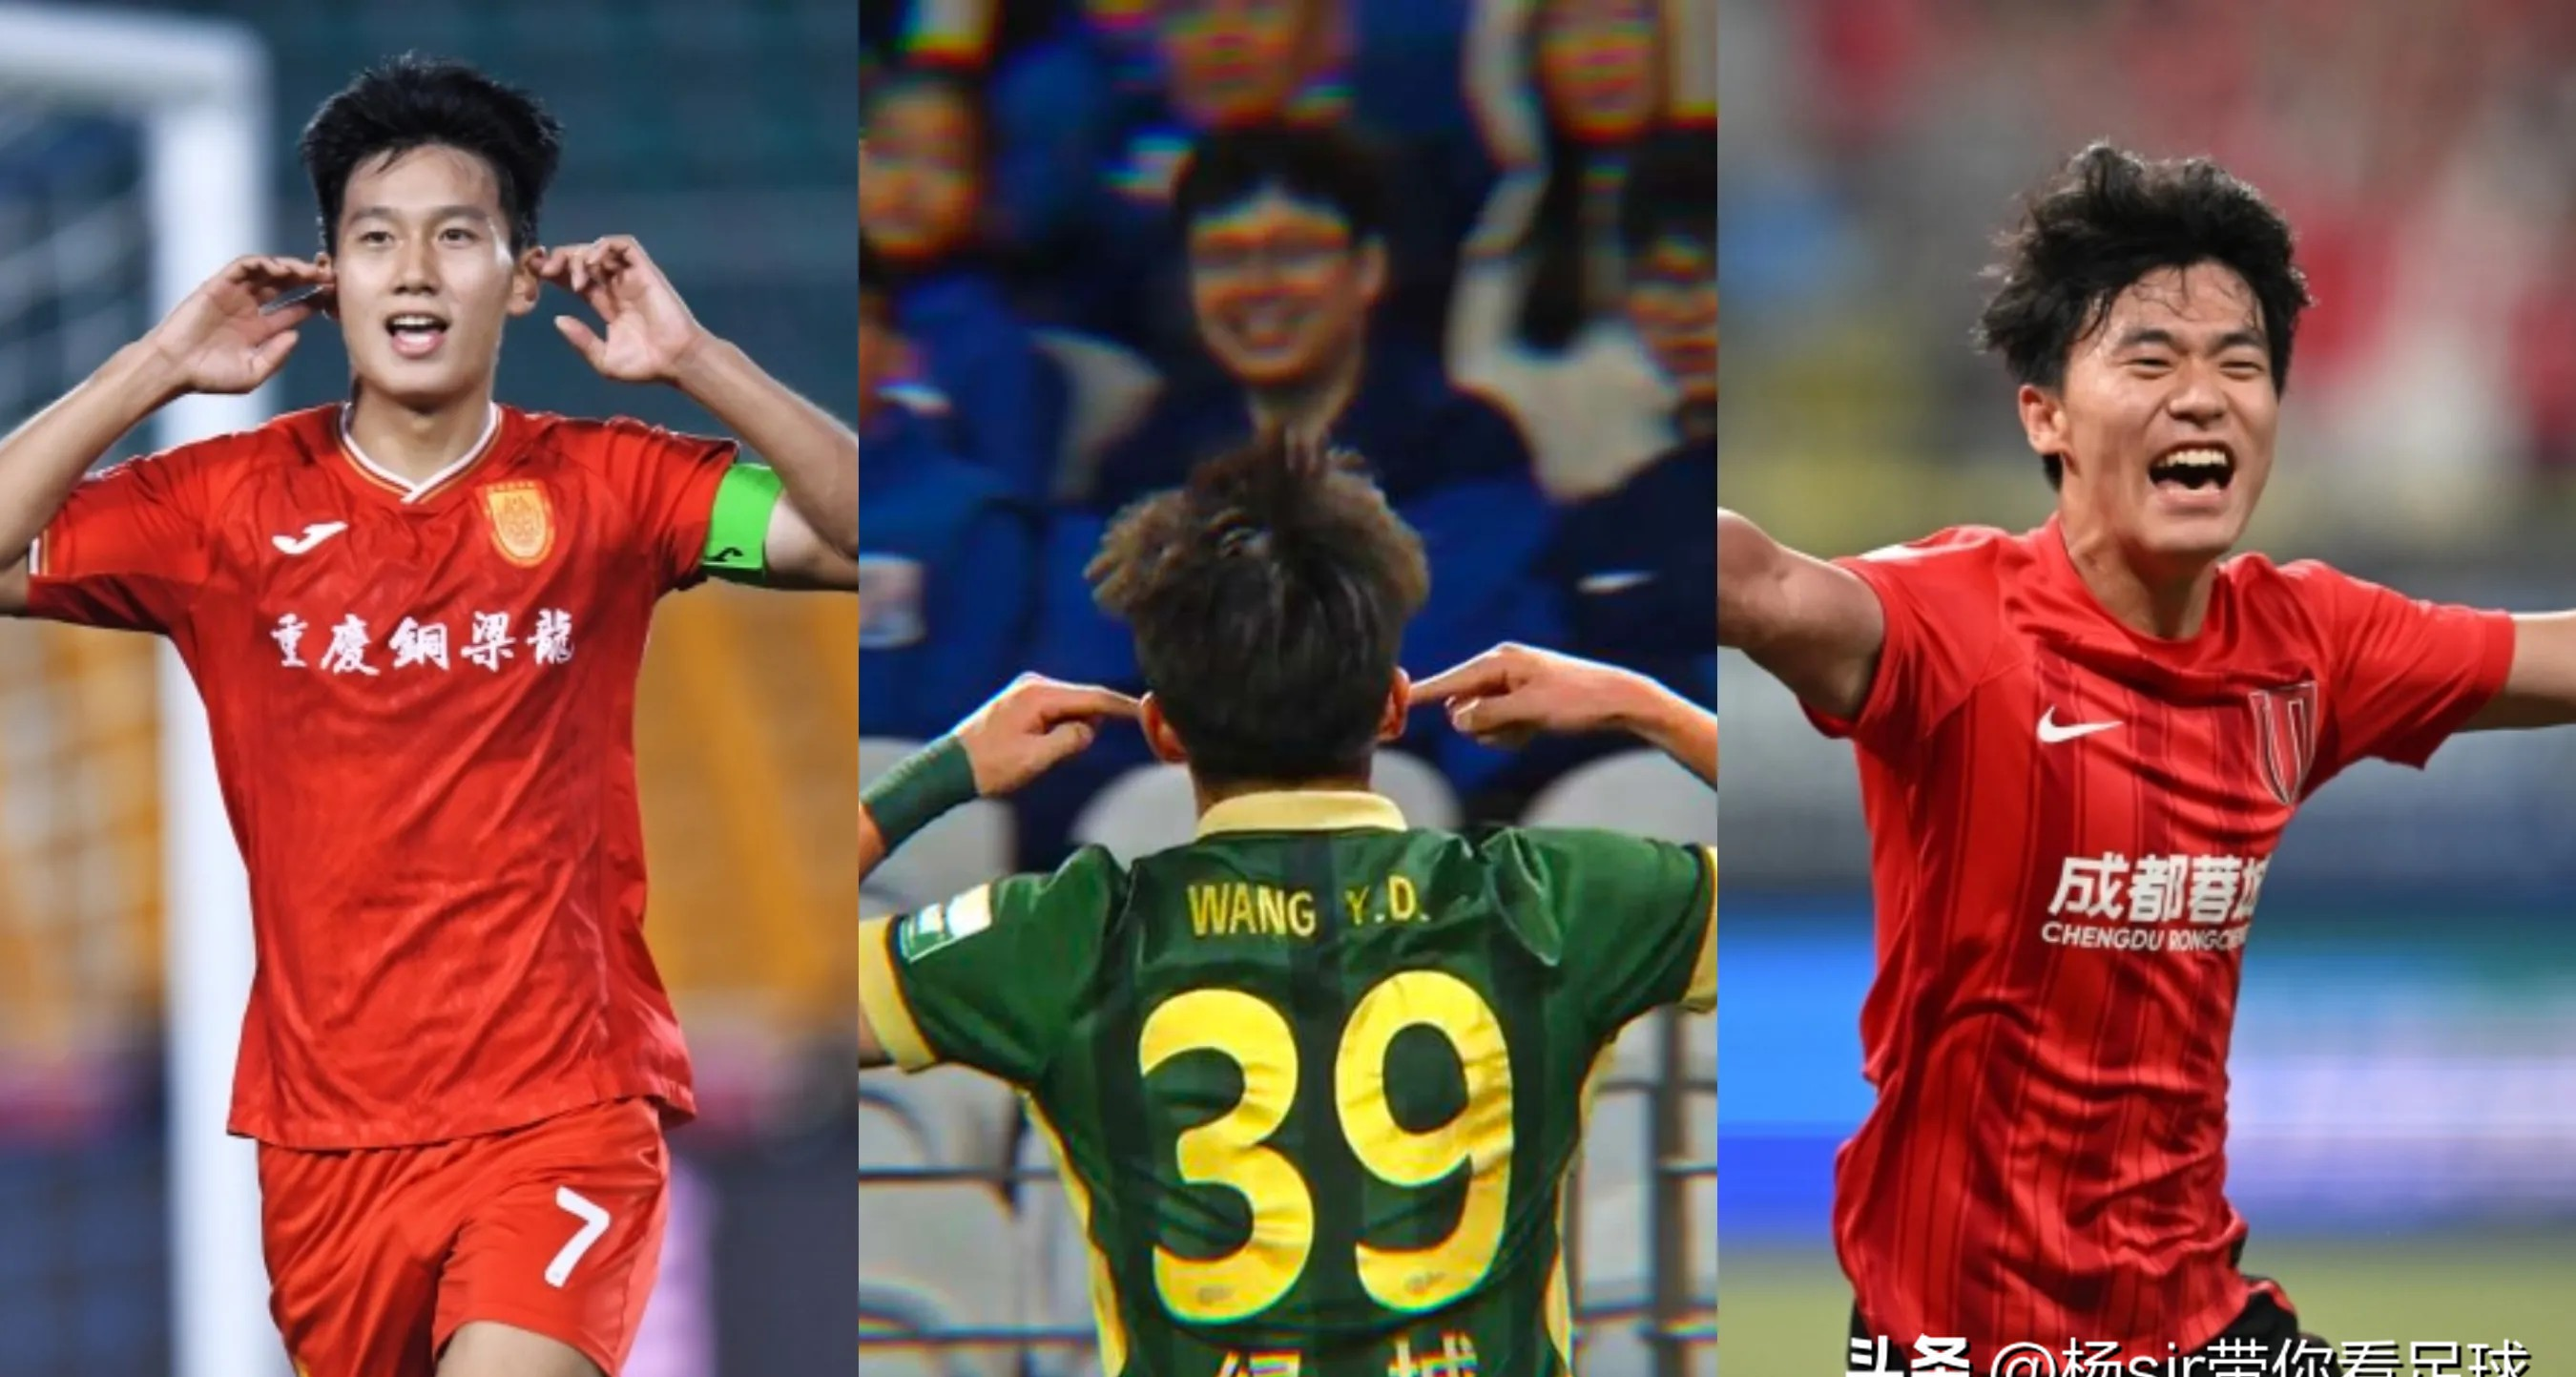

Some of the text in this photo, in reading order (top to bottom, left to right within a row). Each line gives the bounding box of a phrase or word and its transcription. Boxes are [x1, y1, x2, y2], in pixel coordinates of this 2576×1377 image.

[270, 608, 574, 676] 重慶銅梁龍
[1187, 874, 1430, 938] WANG Y.D.
[2042, 921, 2165, 951] CHENGDU
[1139, 970, 1513, 1324] 39
[544, 1184, 612, 1288] 7
